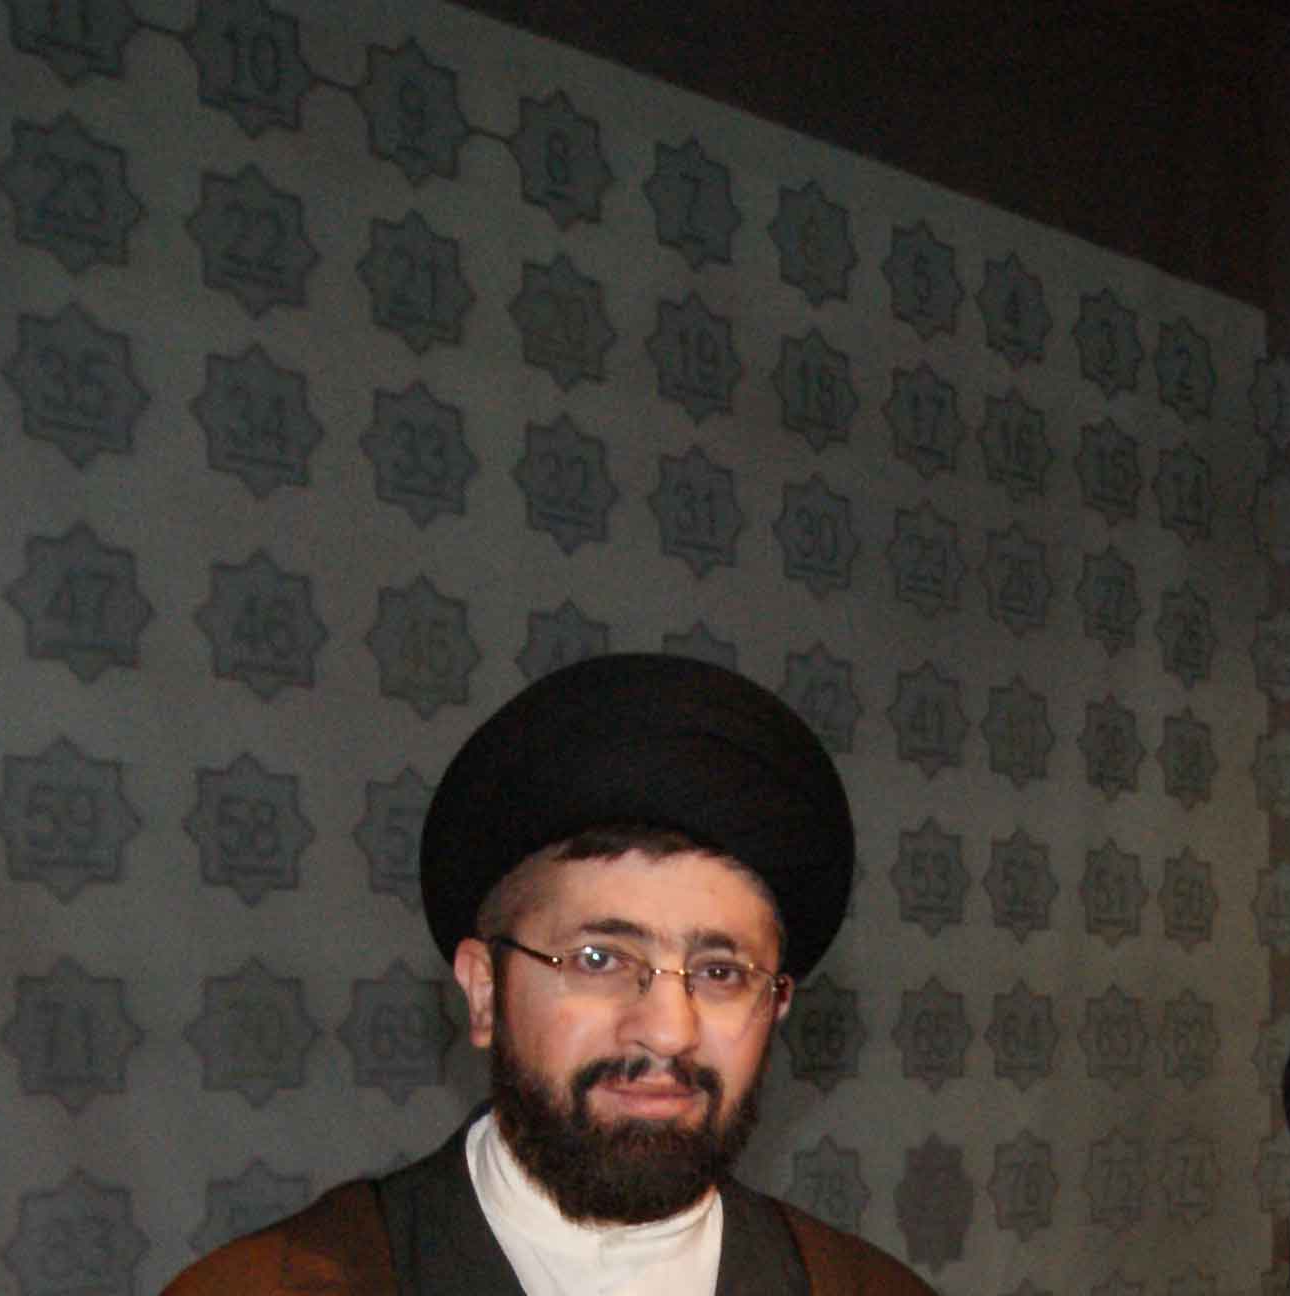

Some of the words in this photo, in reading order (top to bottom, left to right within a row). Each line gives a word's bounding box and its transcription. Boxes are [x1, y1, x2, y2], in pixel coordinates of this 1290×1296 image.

[223, 24, 282, 95] 10
[398, 80, 429, 137] 9
[546, 131, 571, 185] 8
[32, 153, 105, 224] 23
[679, 171, 703, 228] 7
[223, 203, 286, 274] 22
[392, 246, 437, 315] 21
[39, 345, 110, 420] 35
[678, 328, 718, 381] 19
[797, 360, 838, 413] 18
[231, 386, 287, 455] 34
[911, 394, 947, 446] 17
[392, 420, 447, 487] 33
[542, 451, 594, 514] 32
[676, 481, 717, 536] 31
[794, 506, 838, 564] 30
[47, 570, 115, 627] 47
[233, 597, 297, 658] 46
[401, 618, 451, 678] 45
[911, 697, 945, 748] 41
[26, 783, 100, 850] 59
[218, 797, 280, 857] 58
[911, 850, 951, 901] 53
[36, 1003, 94, 1068] 71
[219, 1002, 284, 1062] 70
[372, 1004, 423, 1060] 69
[914, 1011, 952, 1058] 65
[41, 1217, 112, 1278] 83
